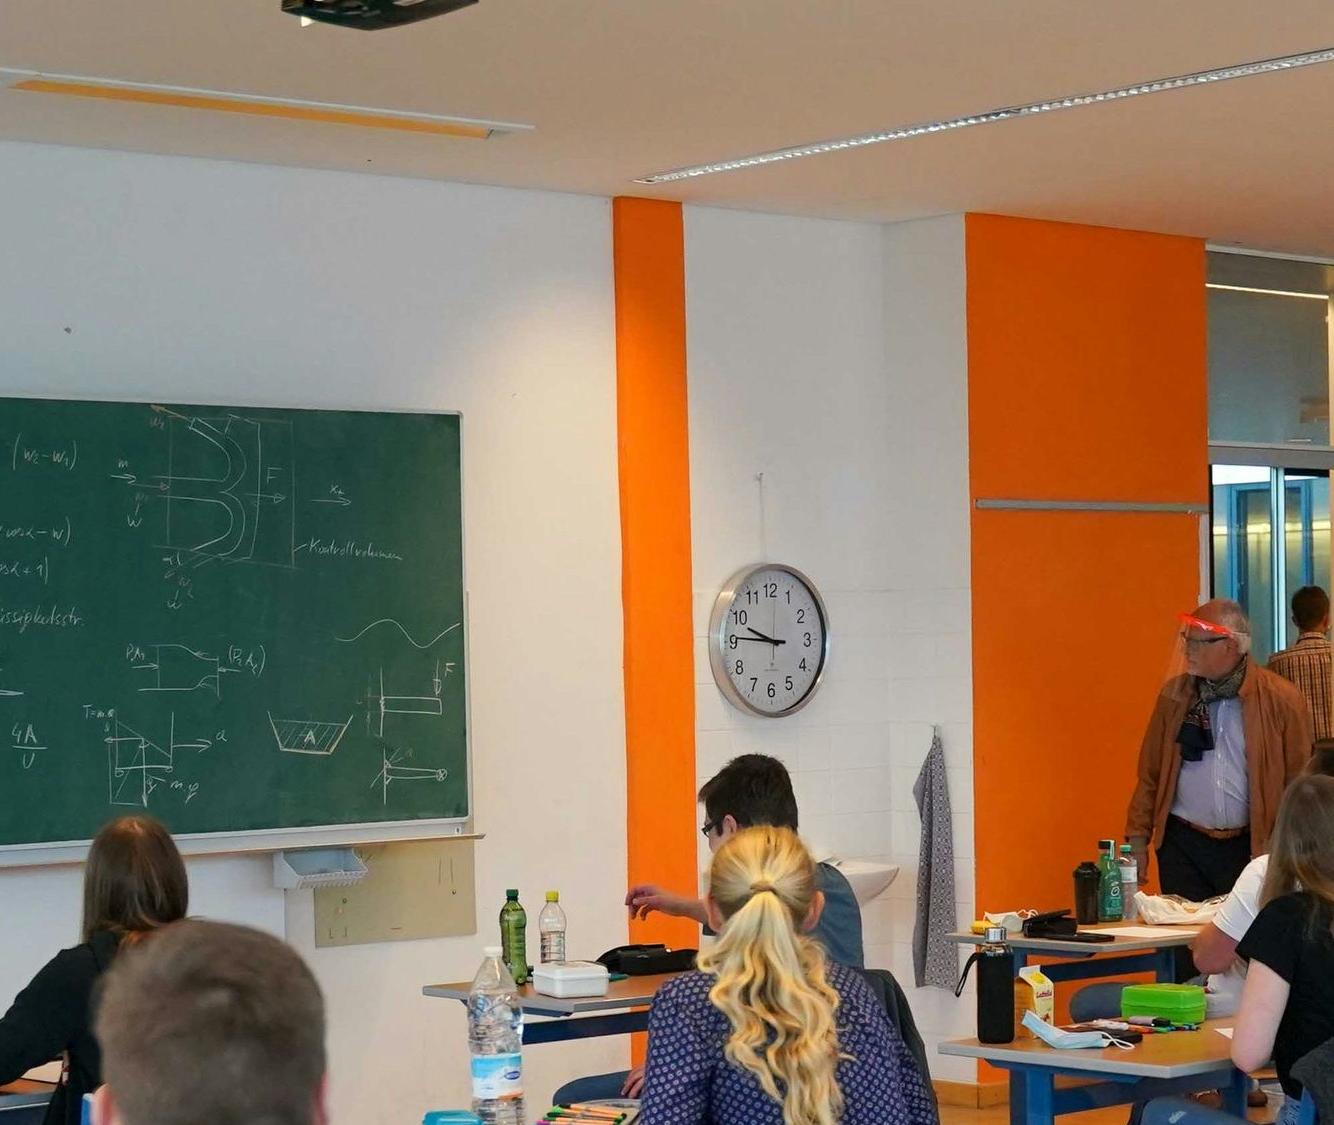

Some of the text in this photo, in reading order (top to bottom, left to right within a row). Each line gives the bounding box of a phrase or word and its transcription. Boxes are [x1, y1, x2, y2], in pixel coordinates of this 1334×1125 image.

[746, 590, 759, 605] 11
[763, 583, 778, 598] 12
[785, 591, 791, 605] 1
[732, 609, 748, 626] 10
[796, 609, 805, 624] 2
[729, 634, 739, 650] 9
[803, 632, 812, 648] 3
[735, 659, 744, 675] 8
[798, 657, 807, 672] 4
[749, 677, 758, 692] 7
[767, 682, 776, 698] 6
[784, 675, 794, 691] 5
